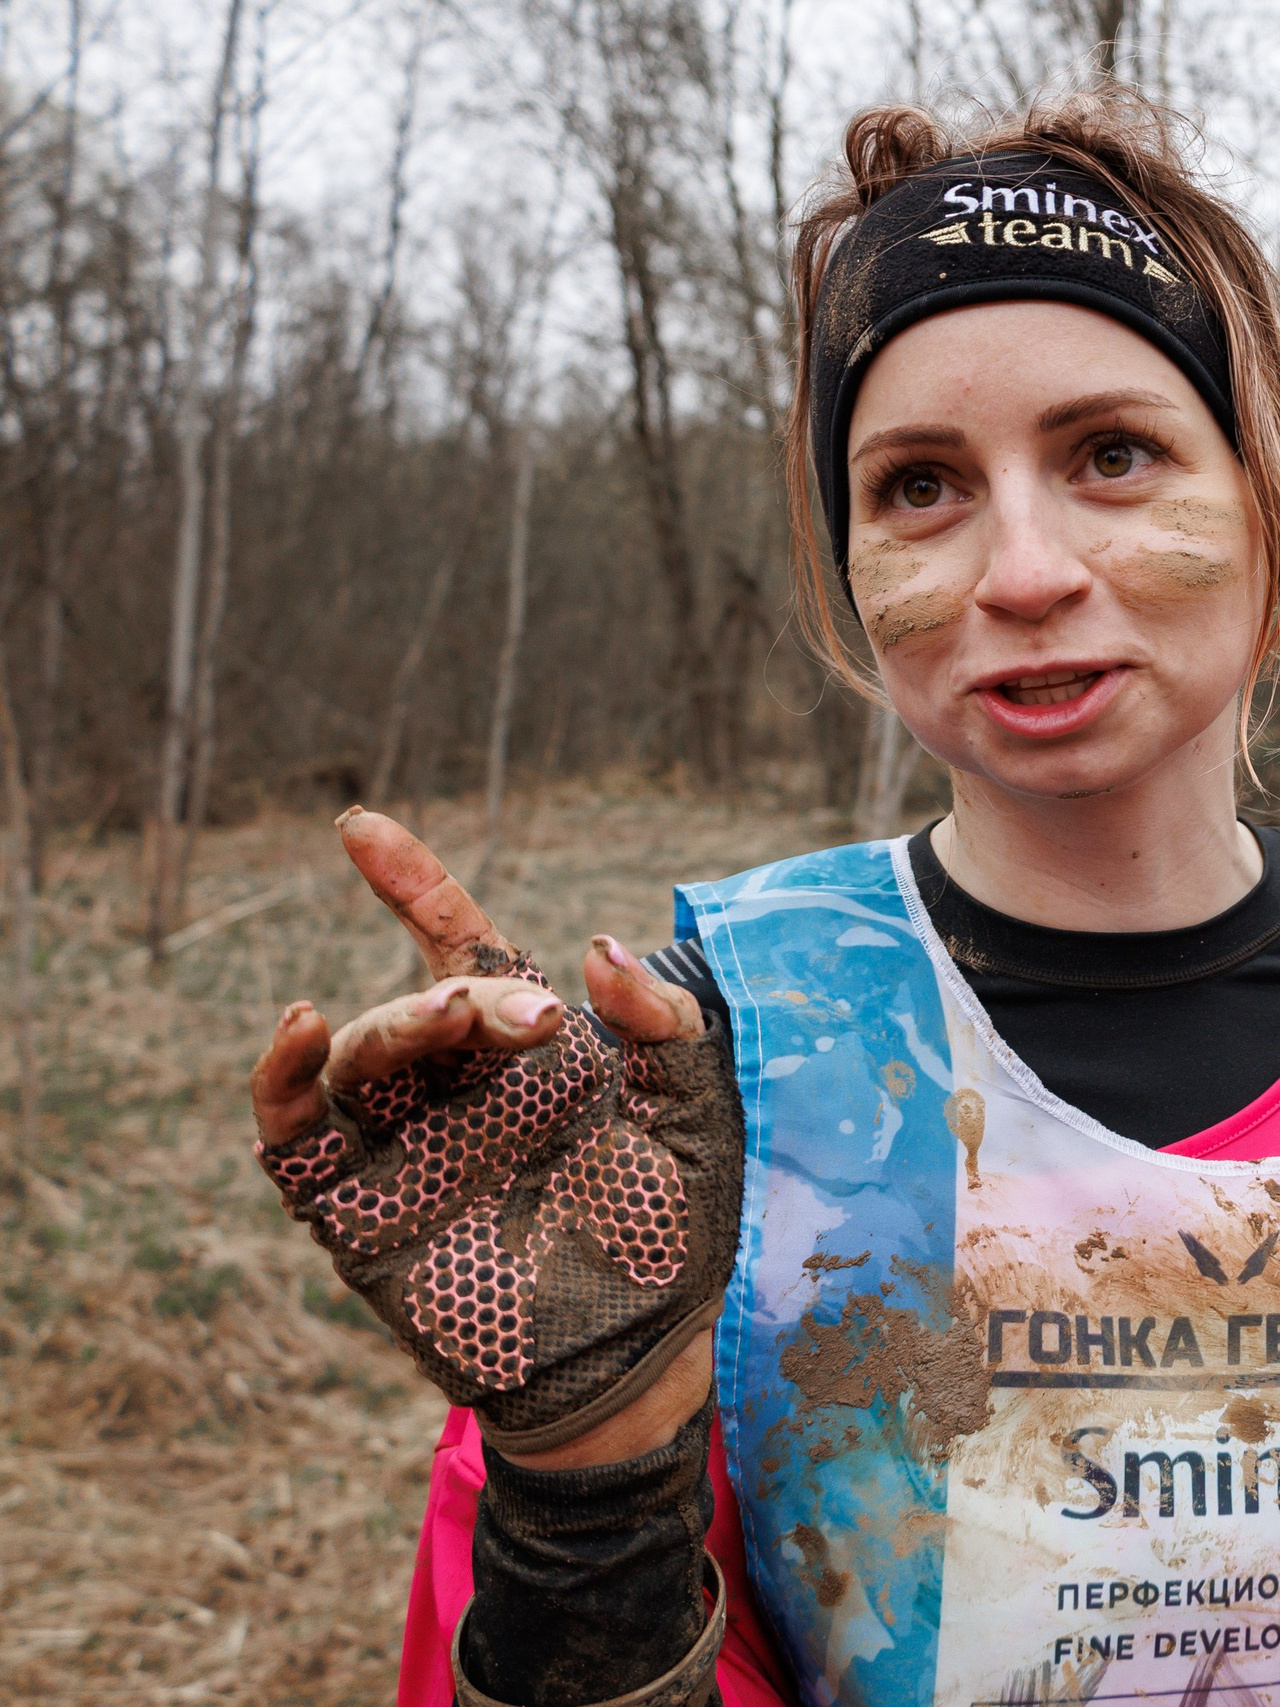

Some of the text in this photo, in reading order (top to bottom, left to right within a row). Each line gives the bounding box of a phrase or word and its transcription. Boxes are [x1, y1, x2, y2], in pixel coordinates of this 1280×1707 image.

[944, 182, 1158, 255] Sminex
[978, 212, 1134, 269] team
[986, 1308, 1204, 1368] ГОНКА
[1054, 1632, 1136, 1665] FINE
